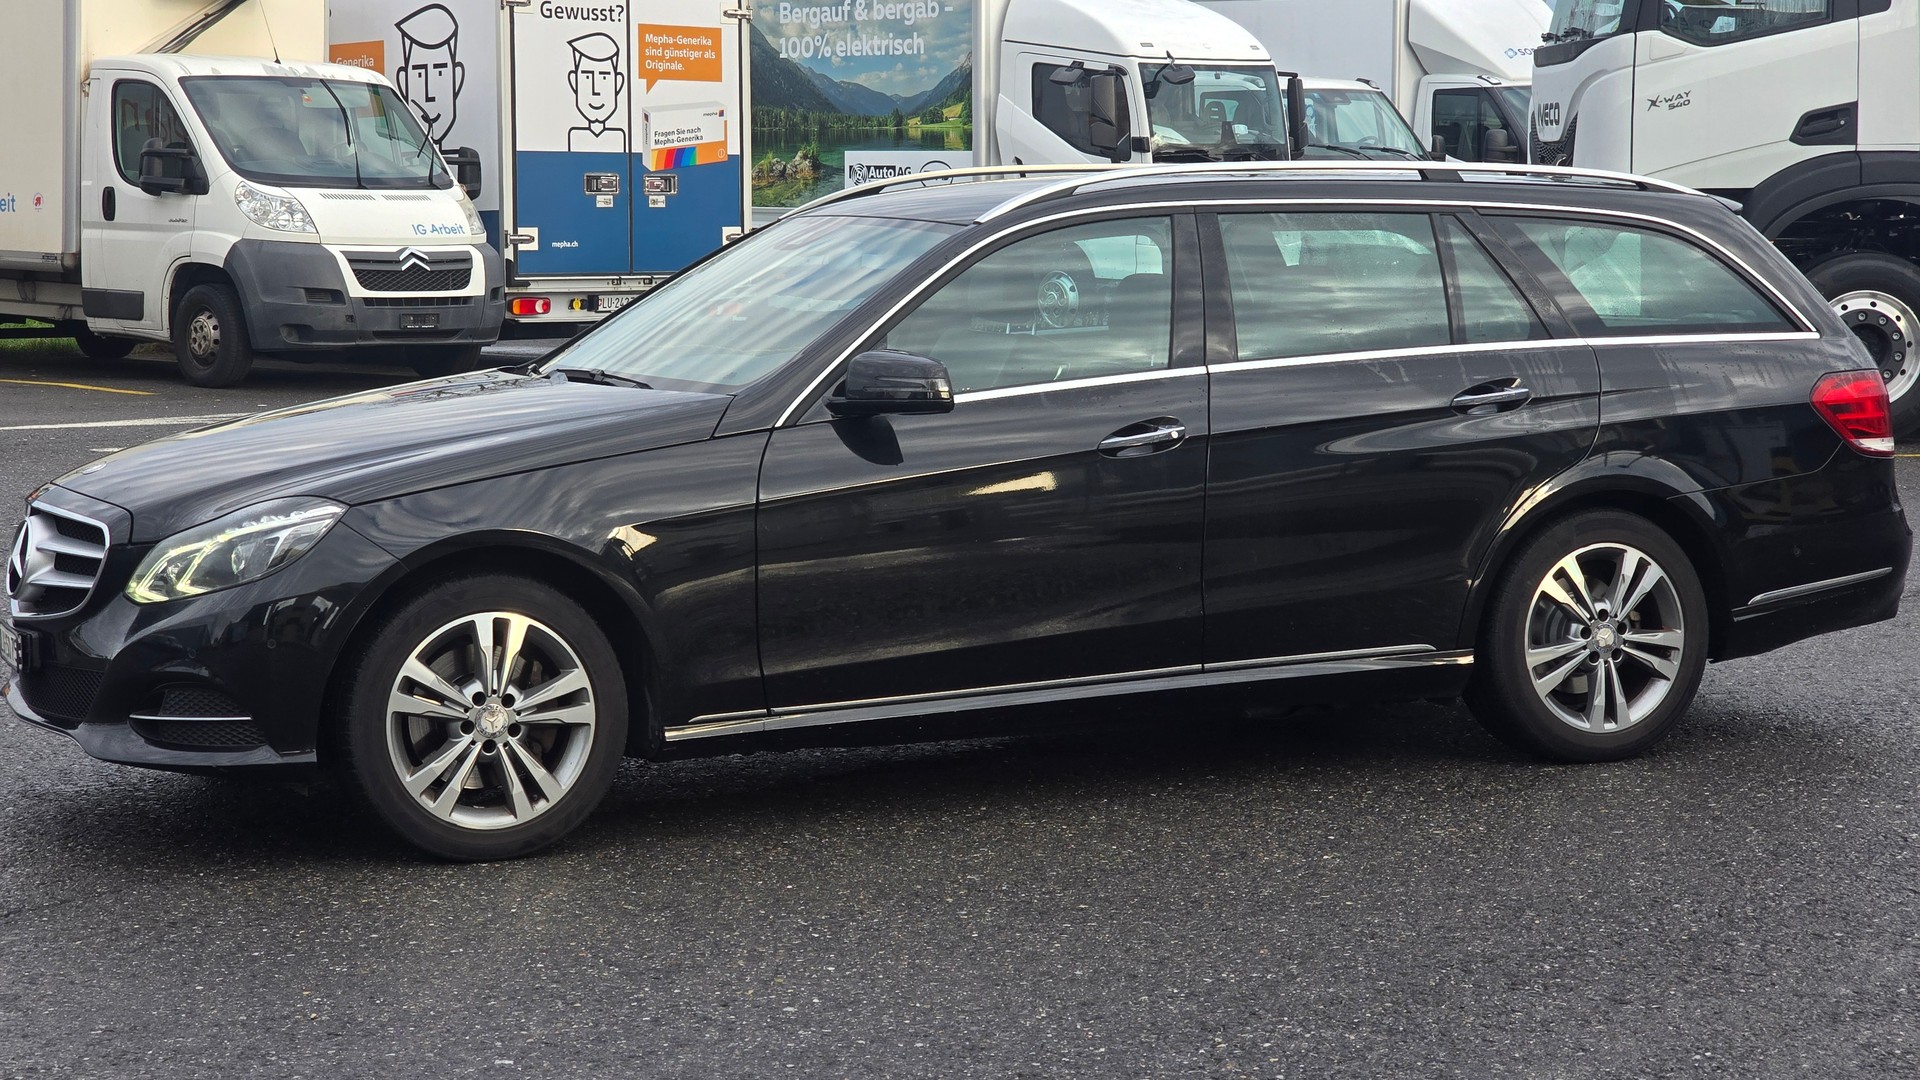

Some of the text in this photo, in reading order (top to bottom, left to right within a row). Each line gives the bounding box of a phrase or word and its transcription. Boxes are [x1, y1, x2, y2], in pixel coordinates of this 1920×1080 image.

[540, 0, 624, 22] Gewusst?
[779, 0, 850, 29] Bergauf
[854, 0, 869, 21] &
[873, 0, 940, 25] bergab
[645, 33, 712, 46] Mepha-Generika
[779, 32, 925, 59] 100% elektrisch
[645, 46, 716, 60] sind günstiger als
[645, 59, 685, 72] Originale.
[1647, 90, 1692, 111] X-WAY
[1668, 99, 1691, 110] 540
[1537, 102, 1560, 127] IVECO
[654, 126, 702, 138] Fragen Sie nach
[654, 134, 704, 146] Mepha-Generika
[868, 166, 912, 179] Auto AG
[411, 222, 466, 235] IG Arbeit
[551, 240, 579, 249] mepha.ch
